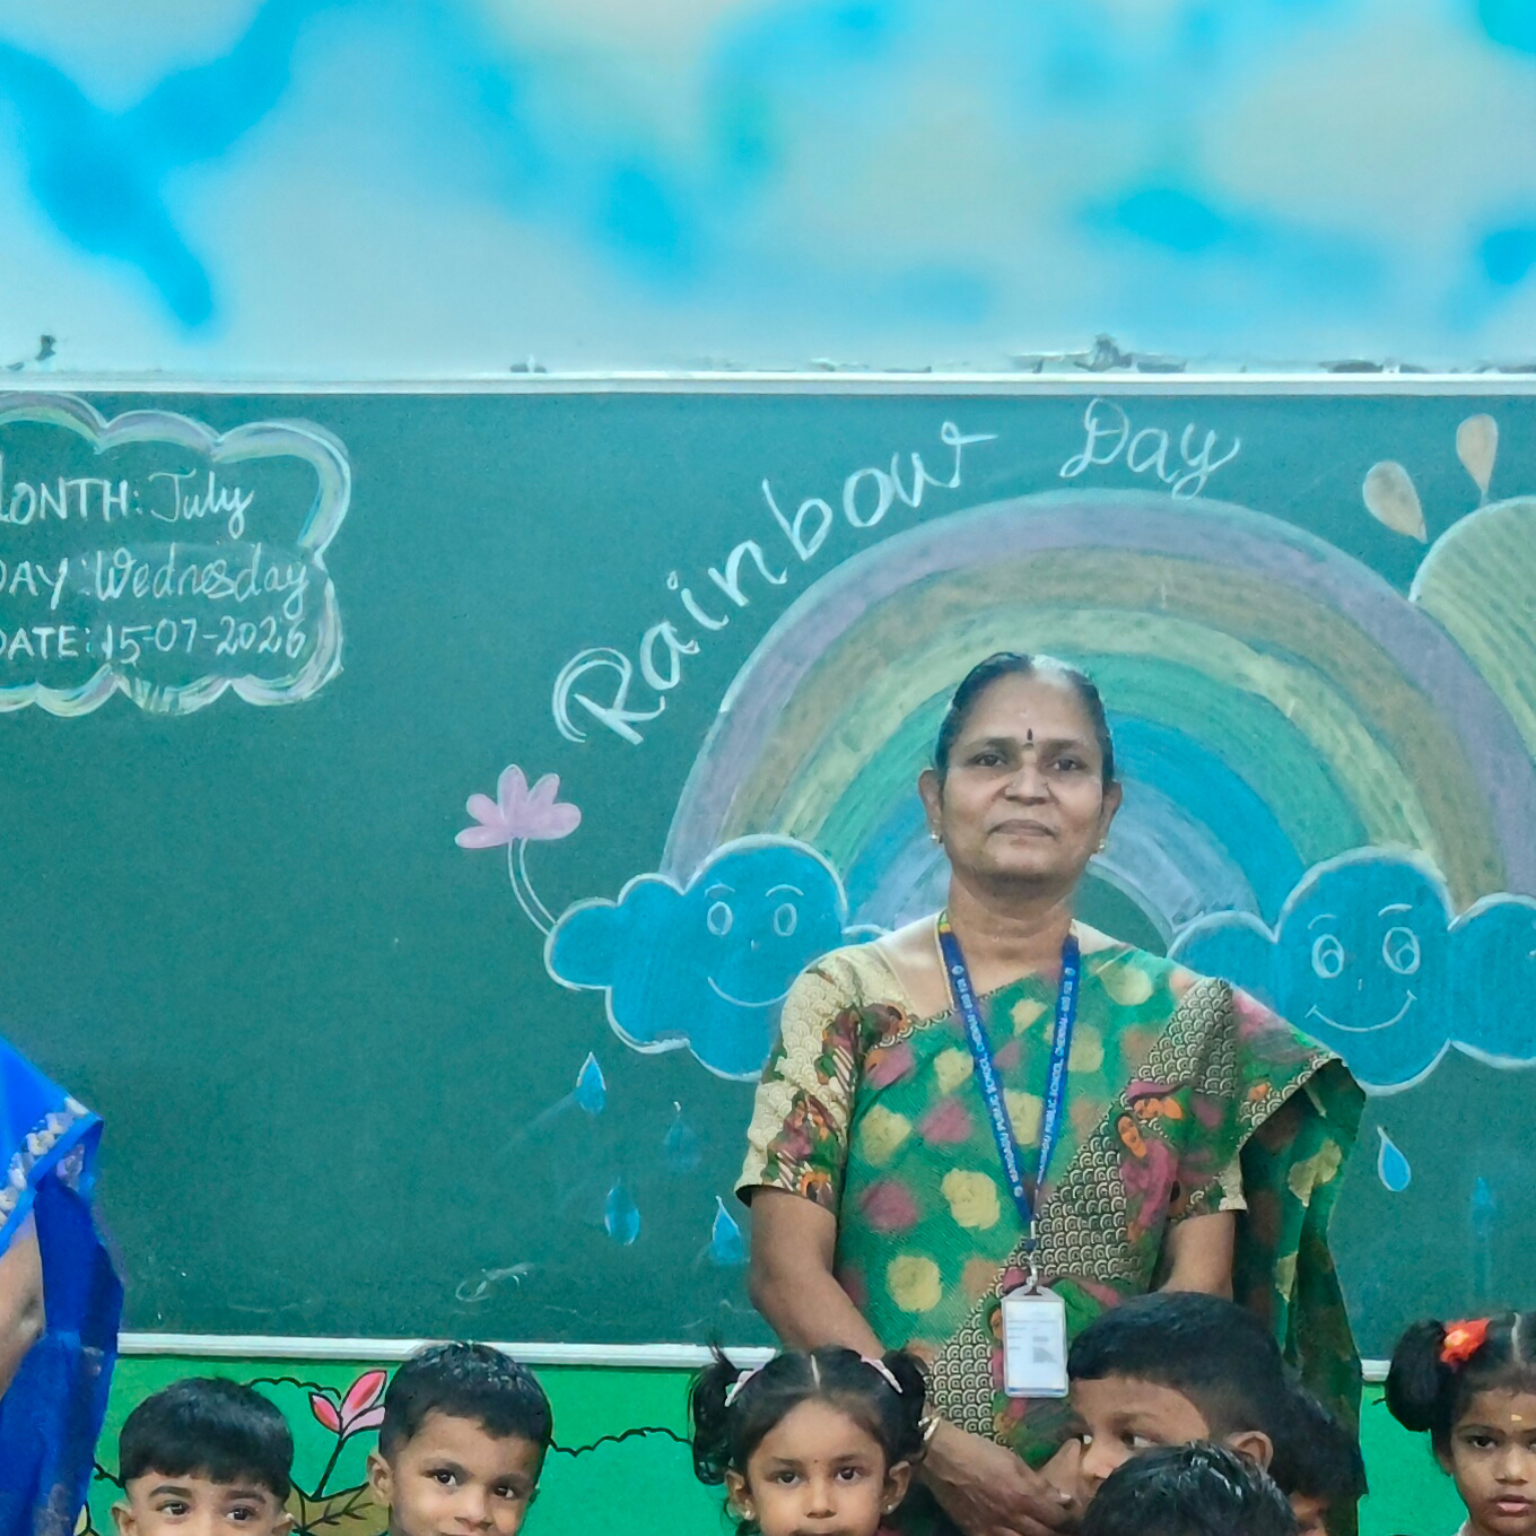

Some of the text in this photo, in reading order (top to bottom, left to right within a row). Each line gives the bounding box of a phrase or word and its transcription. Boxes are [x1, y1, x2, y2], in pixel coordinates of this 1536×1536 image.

[147, 469, 254, 539] July
[552, 398, 1241, 745] Rainbow Day
[100, 615, 307, 664] 15-07-2026
[989, 1095, 1006, 1130] PUBLIC
